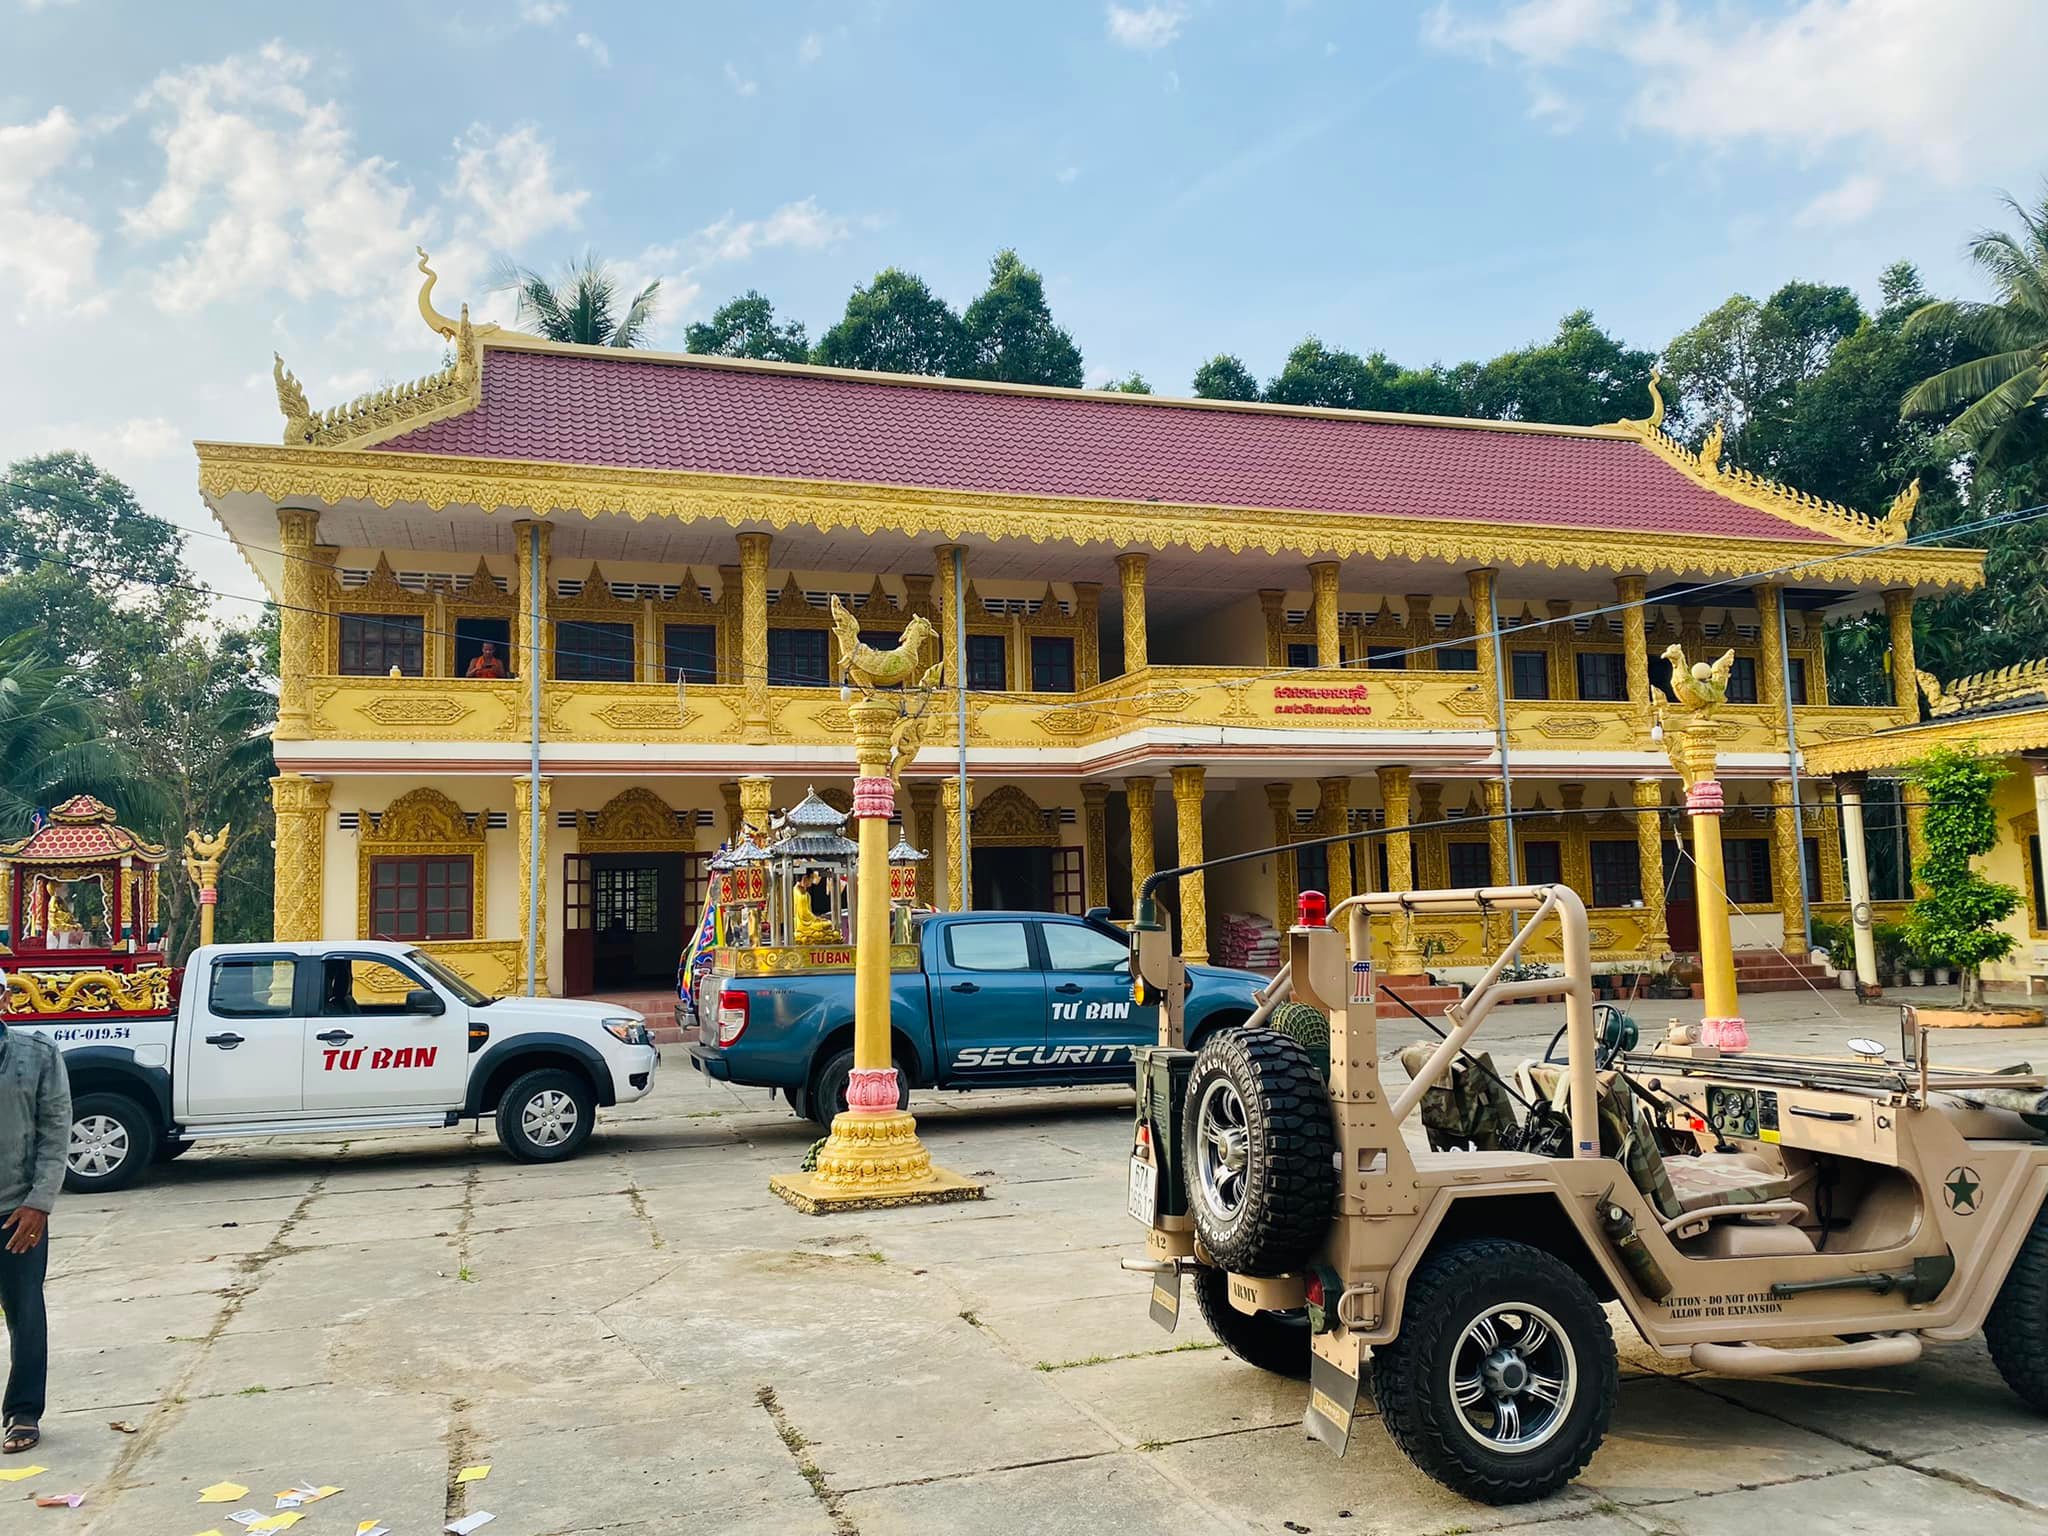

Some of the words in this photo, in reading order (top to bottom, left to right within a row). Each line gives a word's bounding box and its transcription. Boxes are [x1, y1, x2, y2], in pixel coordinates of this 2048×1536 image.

[1051, 1000, 1083, 1020] TƯ
[1085, 1001, 1131, 1020] BAN
[54, 1027, 130, 1041] 64C-019.54
[322, 1046, 368, 1071] TƯ
[371, 1046, 438, 1069] BAN
[1200, 1058, 1232, 1078] RADIAL
[1233, 1282, 1258, 1304] ARMY
[1709, 1295, 1722, 1305] DO
[1725, 1293, 1745, 1304] NOT
[1670, 1307, 1702, 1319] ALLOW
[1705, 1306, 1725, 1317] FOR
[1727, 1303, 1784, 1316] EXPANSION
